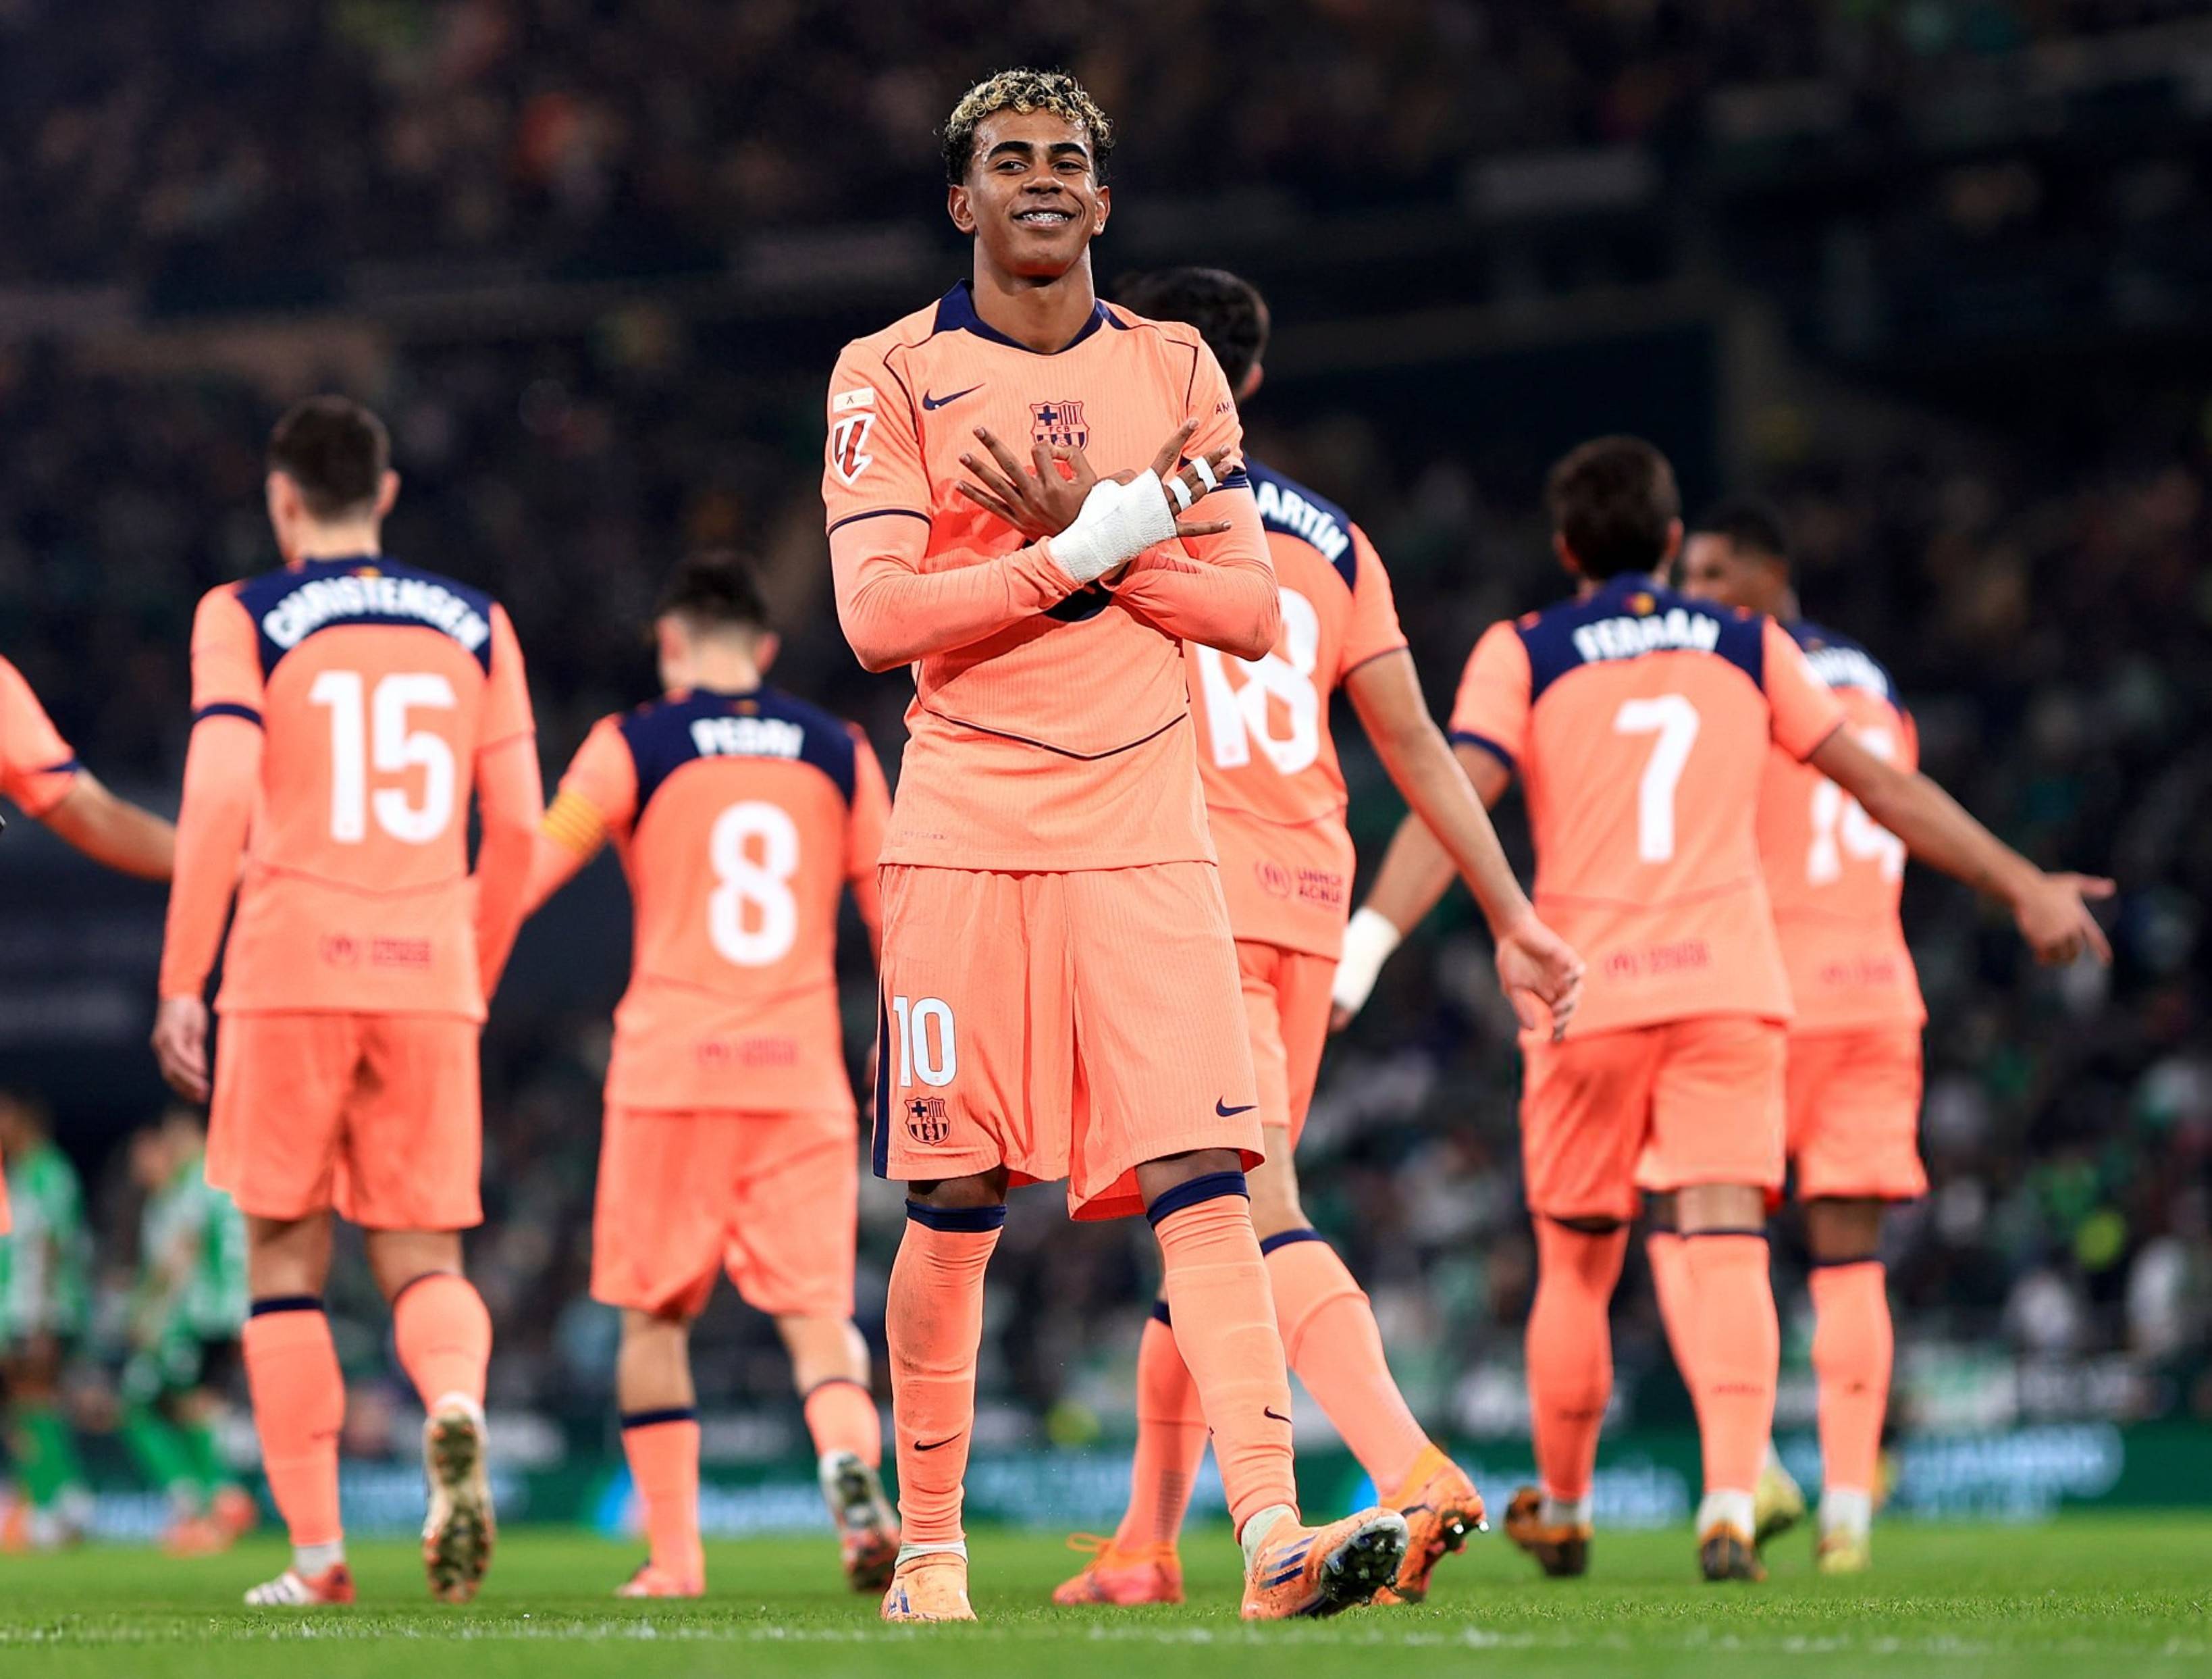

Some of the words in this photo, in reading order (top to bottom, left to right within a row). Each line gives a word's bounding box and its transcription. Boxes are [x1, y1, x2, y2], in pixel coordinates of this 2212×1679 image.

[1257, 481, 1349, 563] ARTÍN
[309, 670, 455, 844] 15
[1615, 694, 1699, 864] 7
[708, 800, 798, 967] 8
[894, 996, 957, 1087] 10
